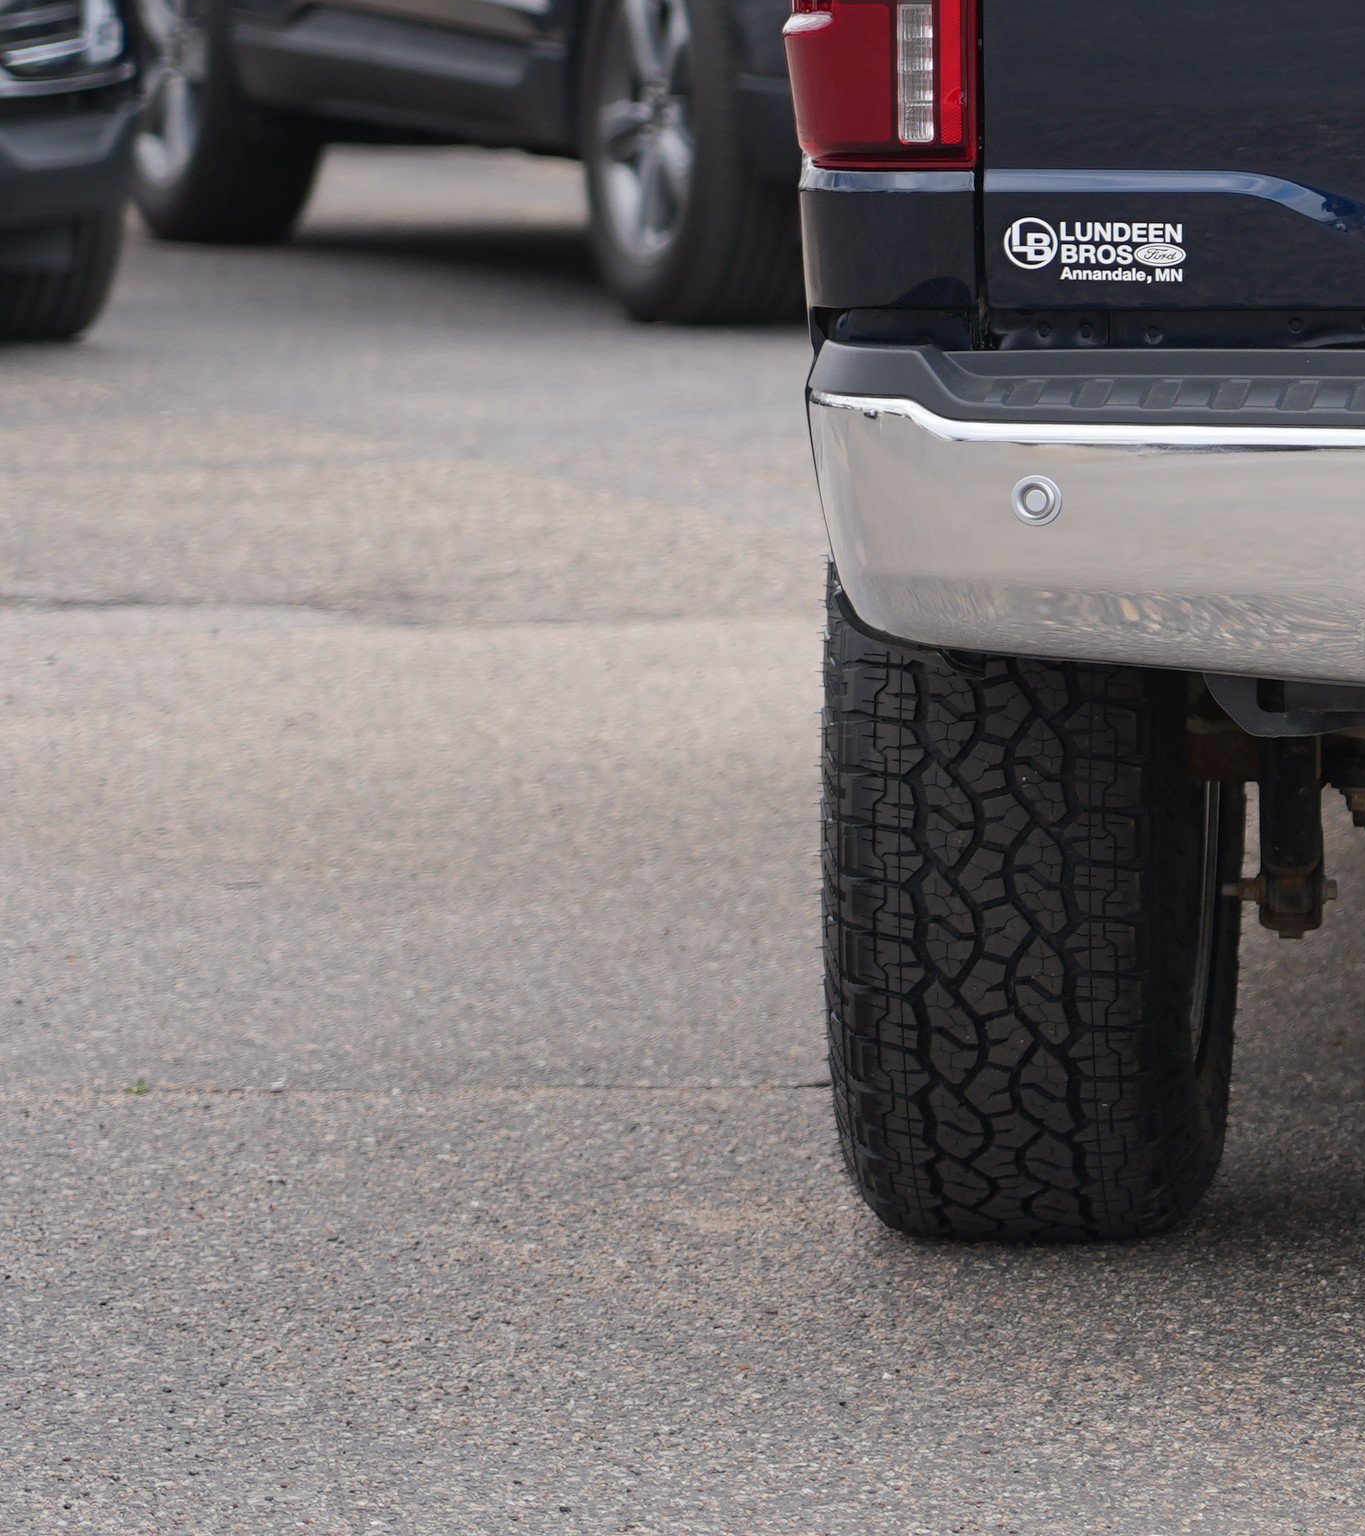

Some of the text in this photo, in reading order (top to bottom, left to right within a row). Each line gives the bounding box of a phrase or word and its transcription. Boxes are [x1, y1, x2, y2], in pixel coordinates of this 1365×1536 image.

[1059, 221, 1183, 244] LUNDEEN
[1060, 244, 1178, 265] BROS Ford
[1059, 266, 1183, 284] Annandale, MN
